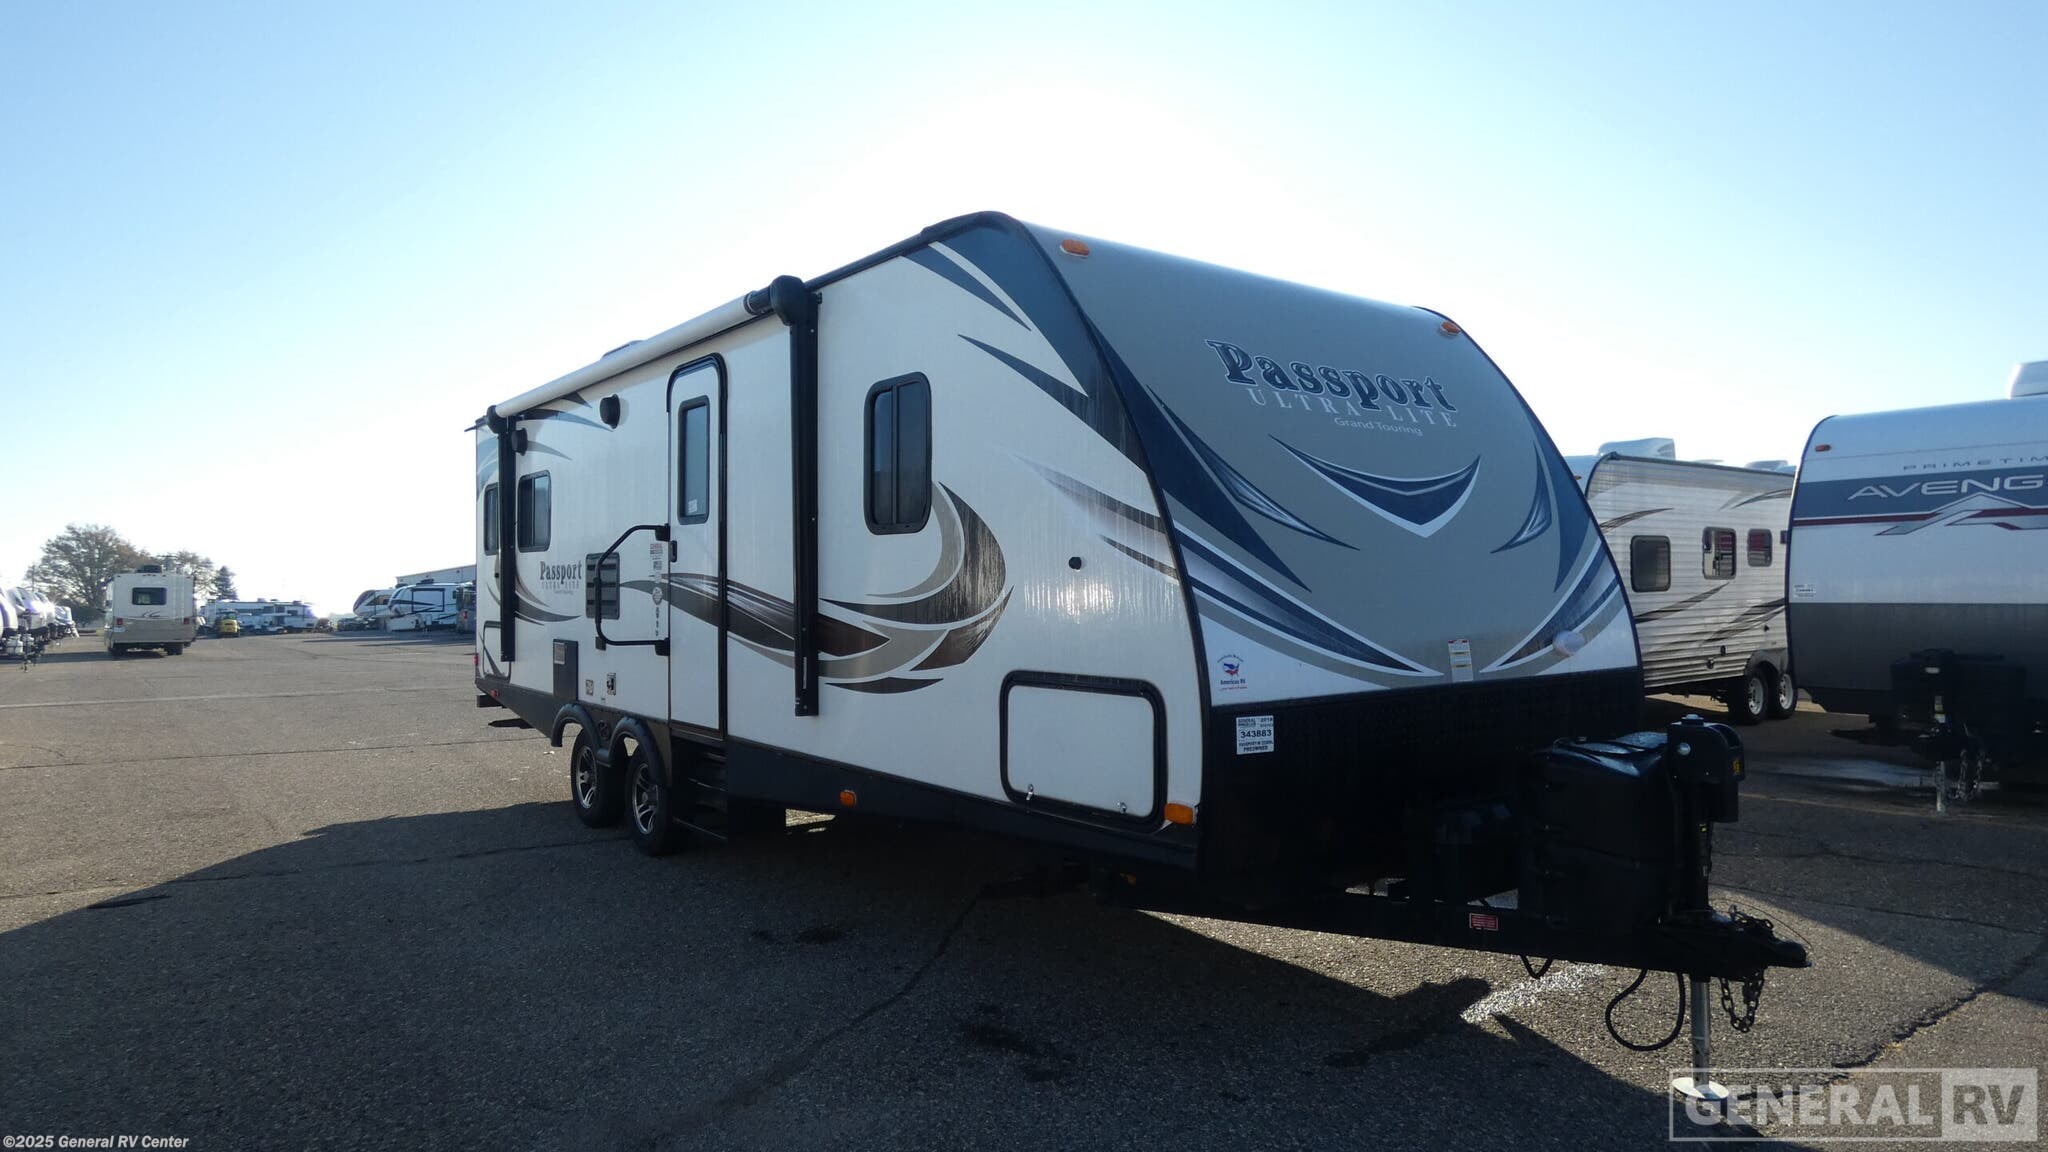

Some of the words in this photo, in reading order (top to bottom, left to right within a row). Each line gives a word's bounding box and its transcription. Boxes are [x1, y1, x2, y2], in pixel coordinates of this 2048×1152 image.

[1205, 339, 1457, 411] Passport
[1247, 387, 1361, 416] ULTRA
[1387, 405, 1457, 427] LITE
[1334, 417, 1374, 430] Grand
[1376, 421, 1423, 436] Touring
[540, 561, 582, 584] Passport
